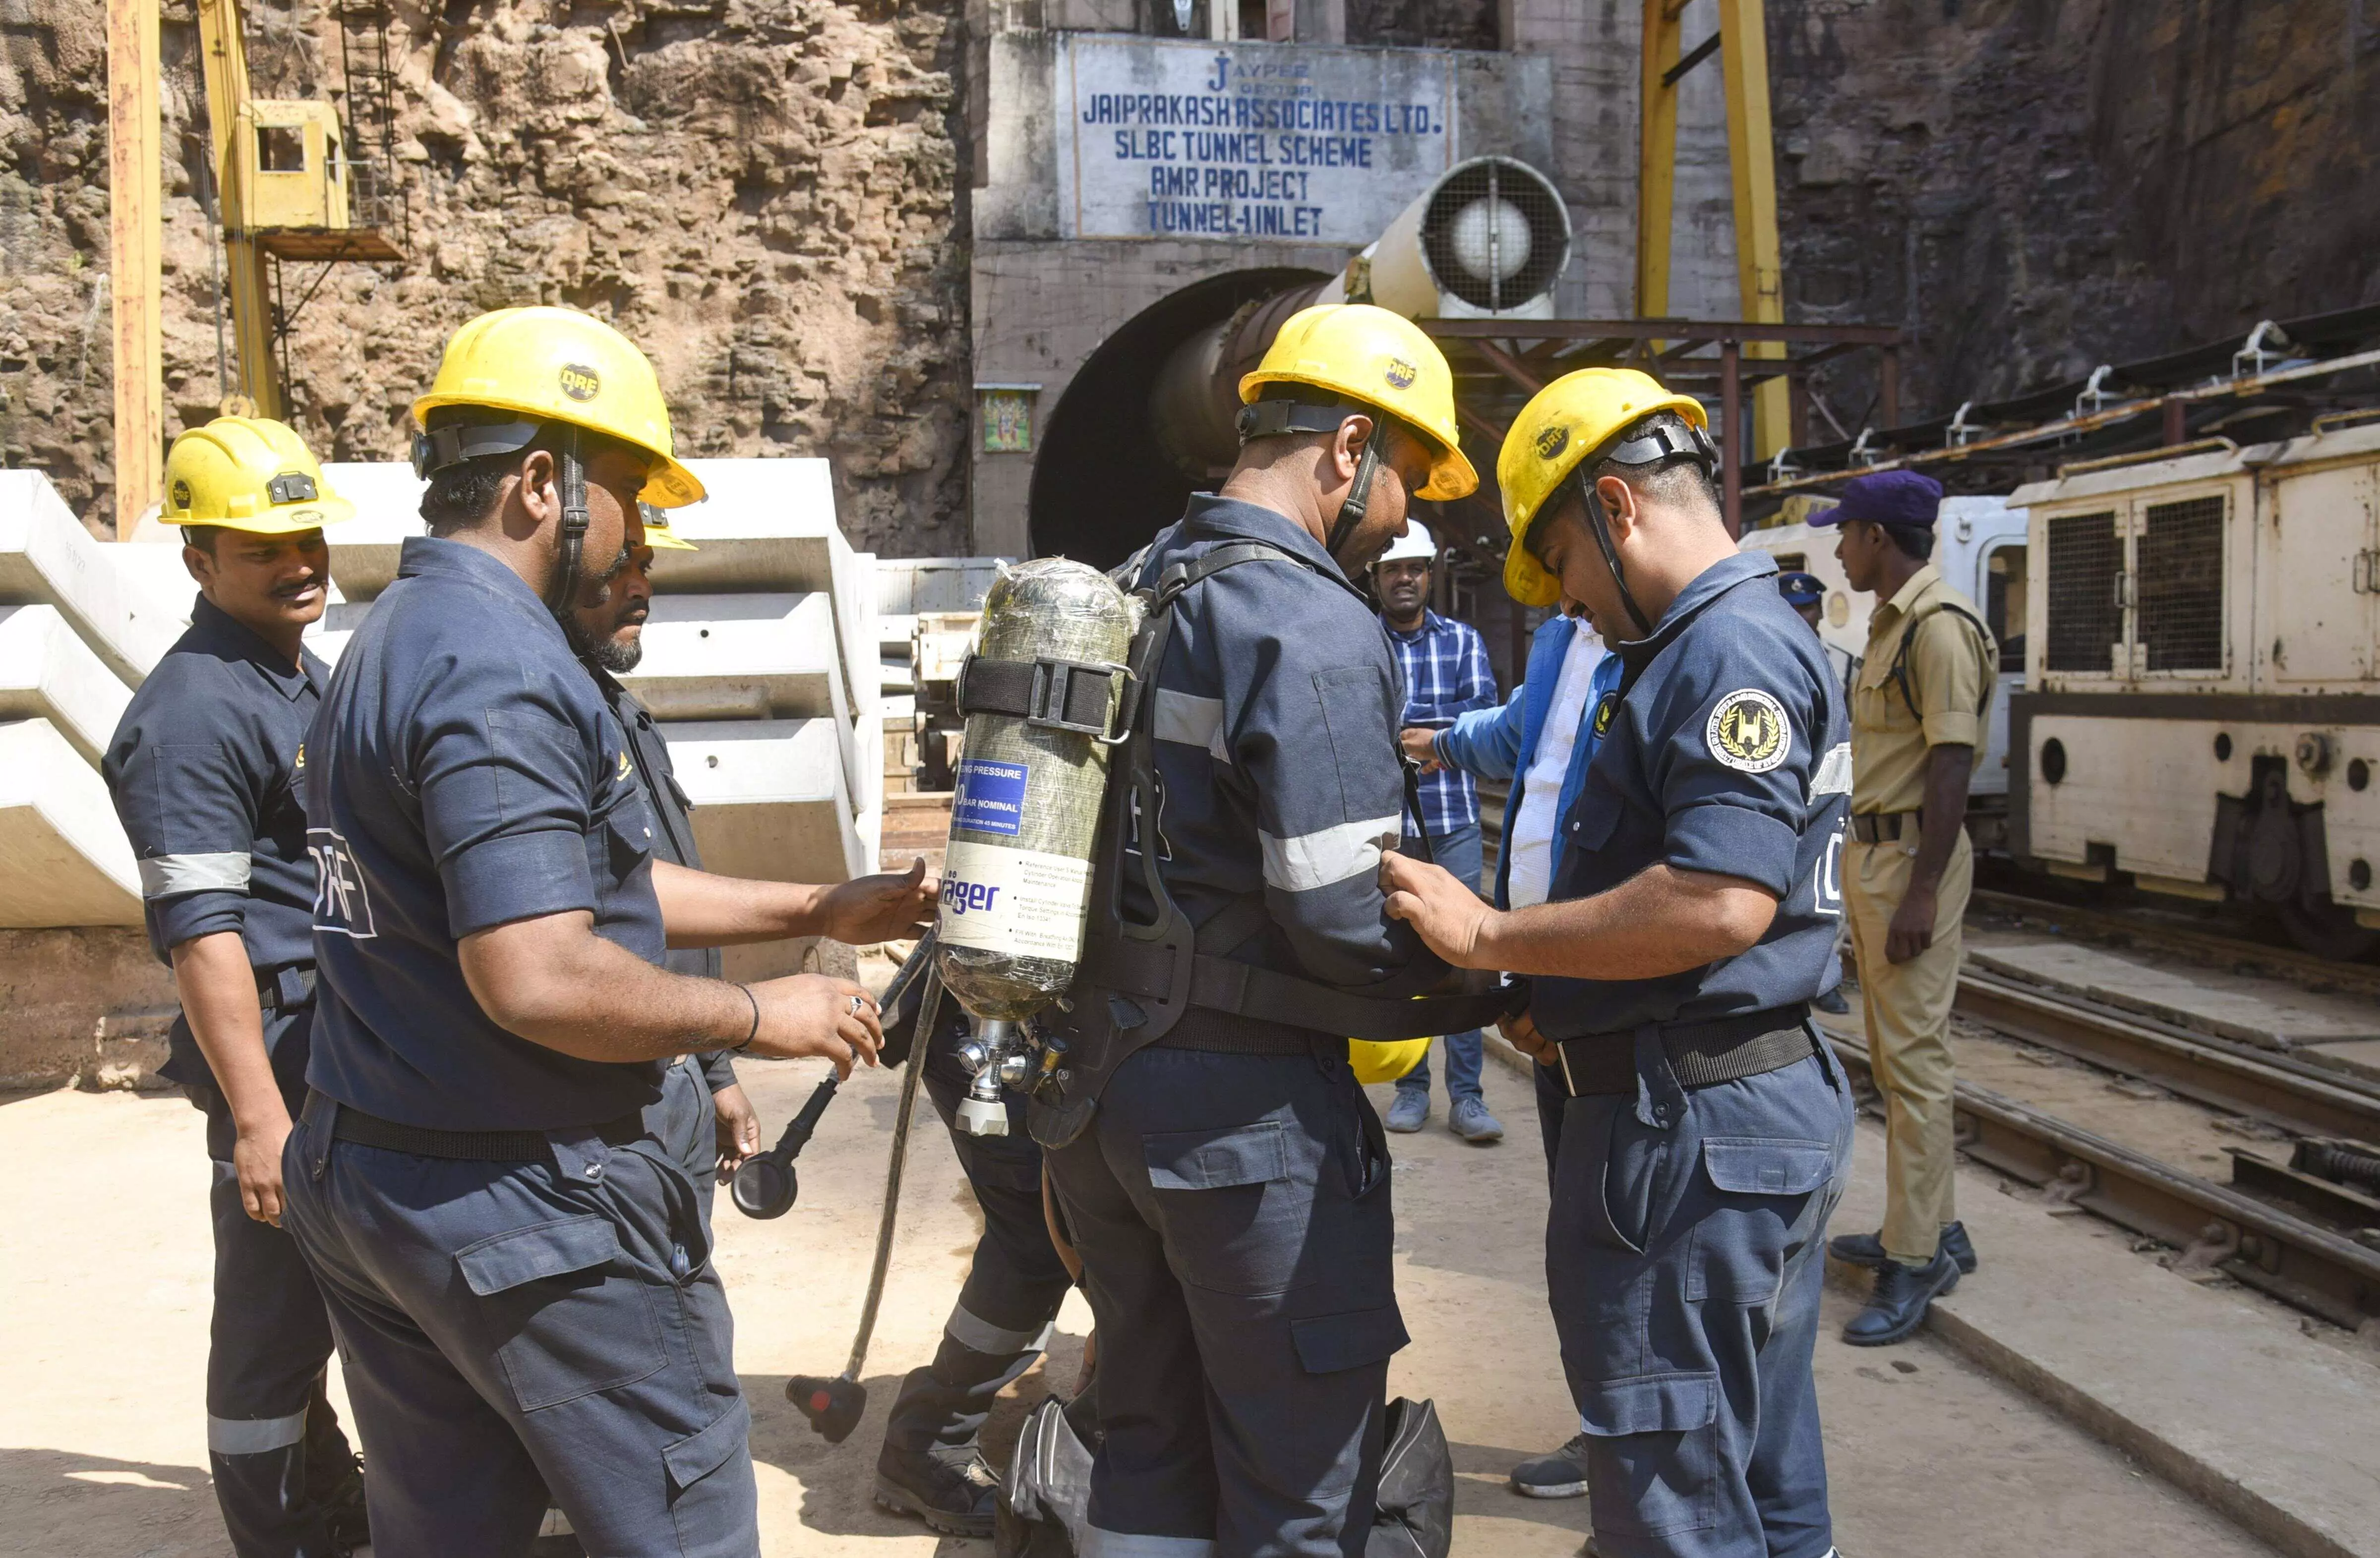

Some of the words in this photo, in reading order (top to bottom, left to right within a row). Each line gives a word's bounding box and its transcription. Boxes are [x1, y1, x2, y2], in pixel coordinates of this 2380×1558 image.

[1083, 94, 1230, 126] JAIPRAKASH
[1236, 97, 1379, 133] ASSOCIATES
[1385, 104, 1442, 134] LTD.
[1115, 130, 1176, 160] SLBC
[1182, 131, 1273, 165] TUNNEL
[1279, 135, 1371, 169] SCHEME
[1151, 166, 1198, 197] AMR
[1204, 168, 1309, 200] PROJECT
[1256, 205, 1322, 236] INLET
[973, 765, 1022, 780] PRESSURE
[963, 797, 977, 807] BAR
[977, 799, 1018, 813] NOMINAL
[991, 821, 1016, 830] MINUTES
